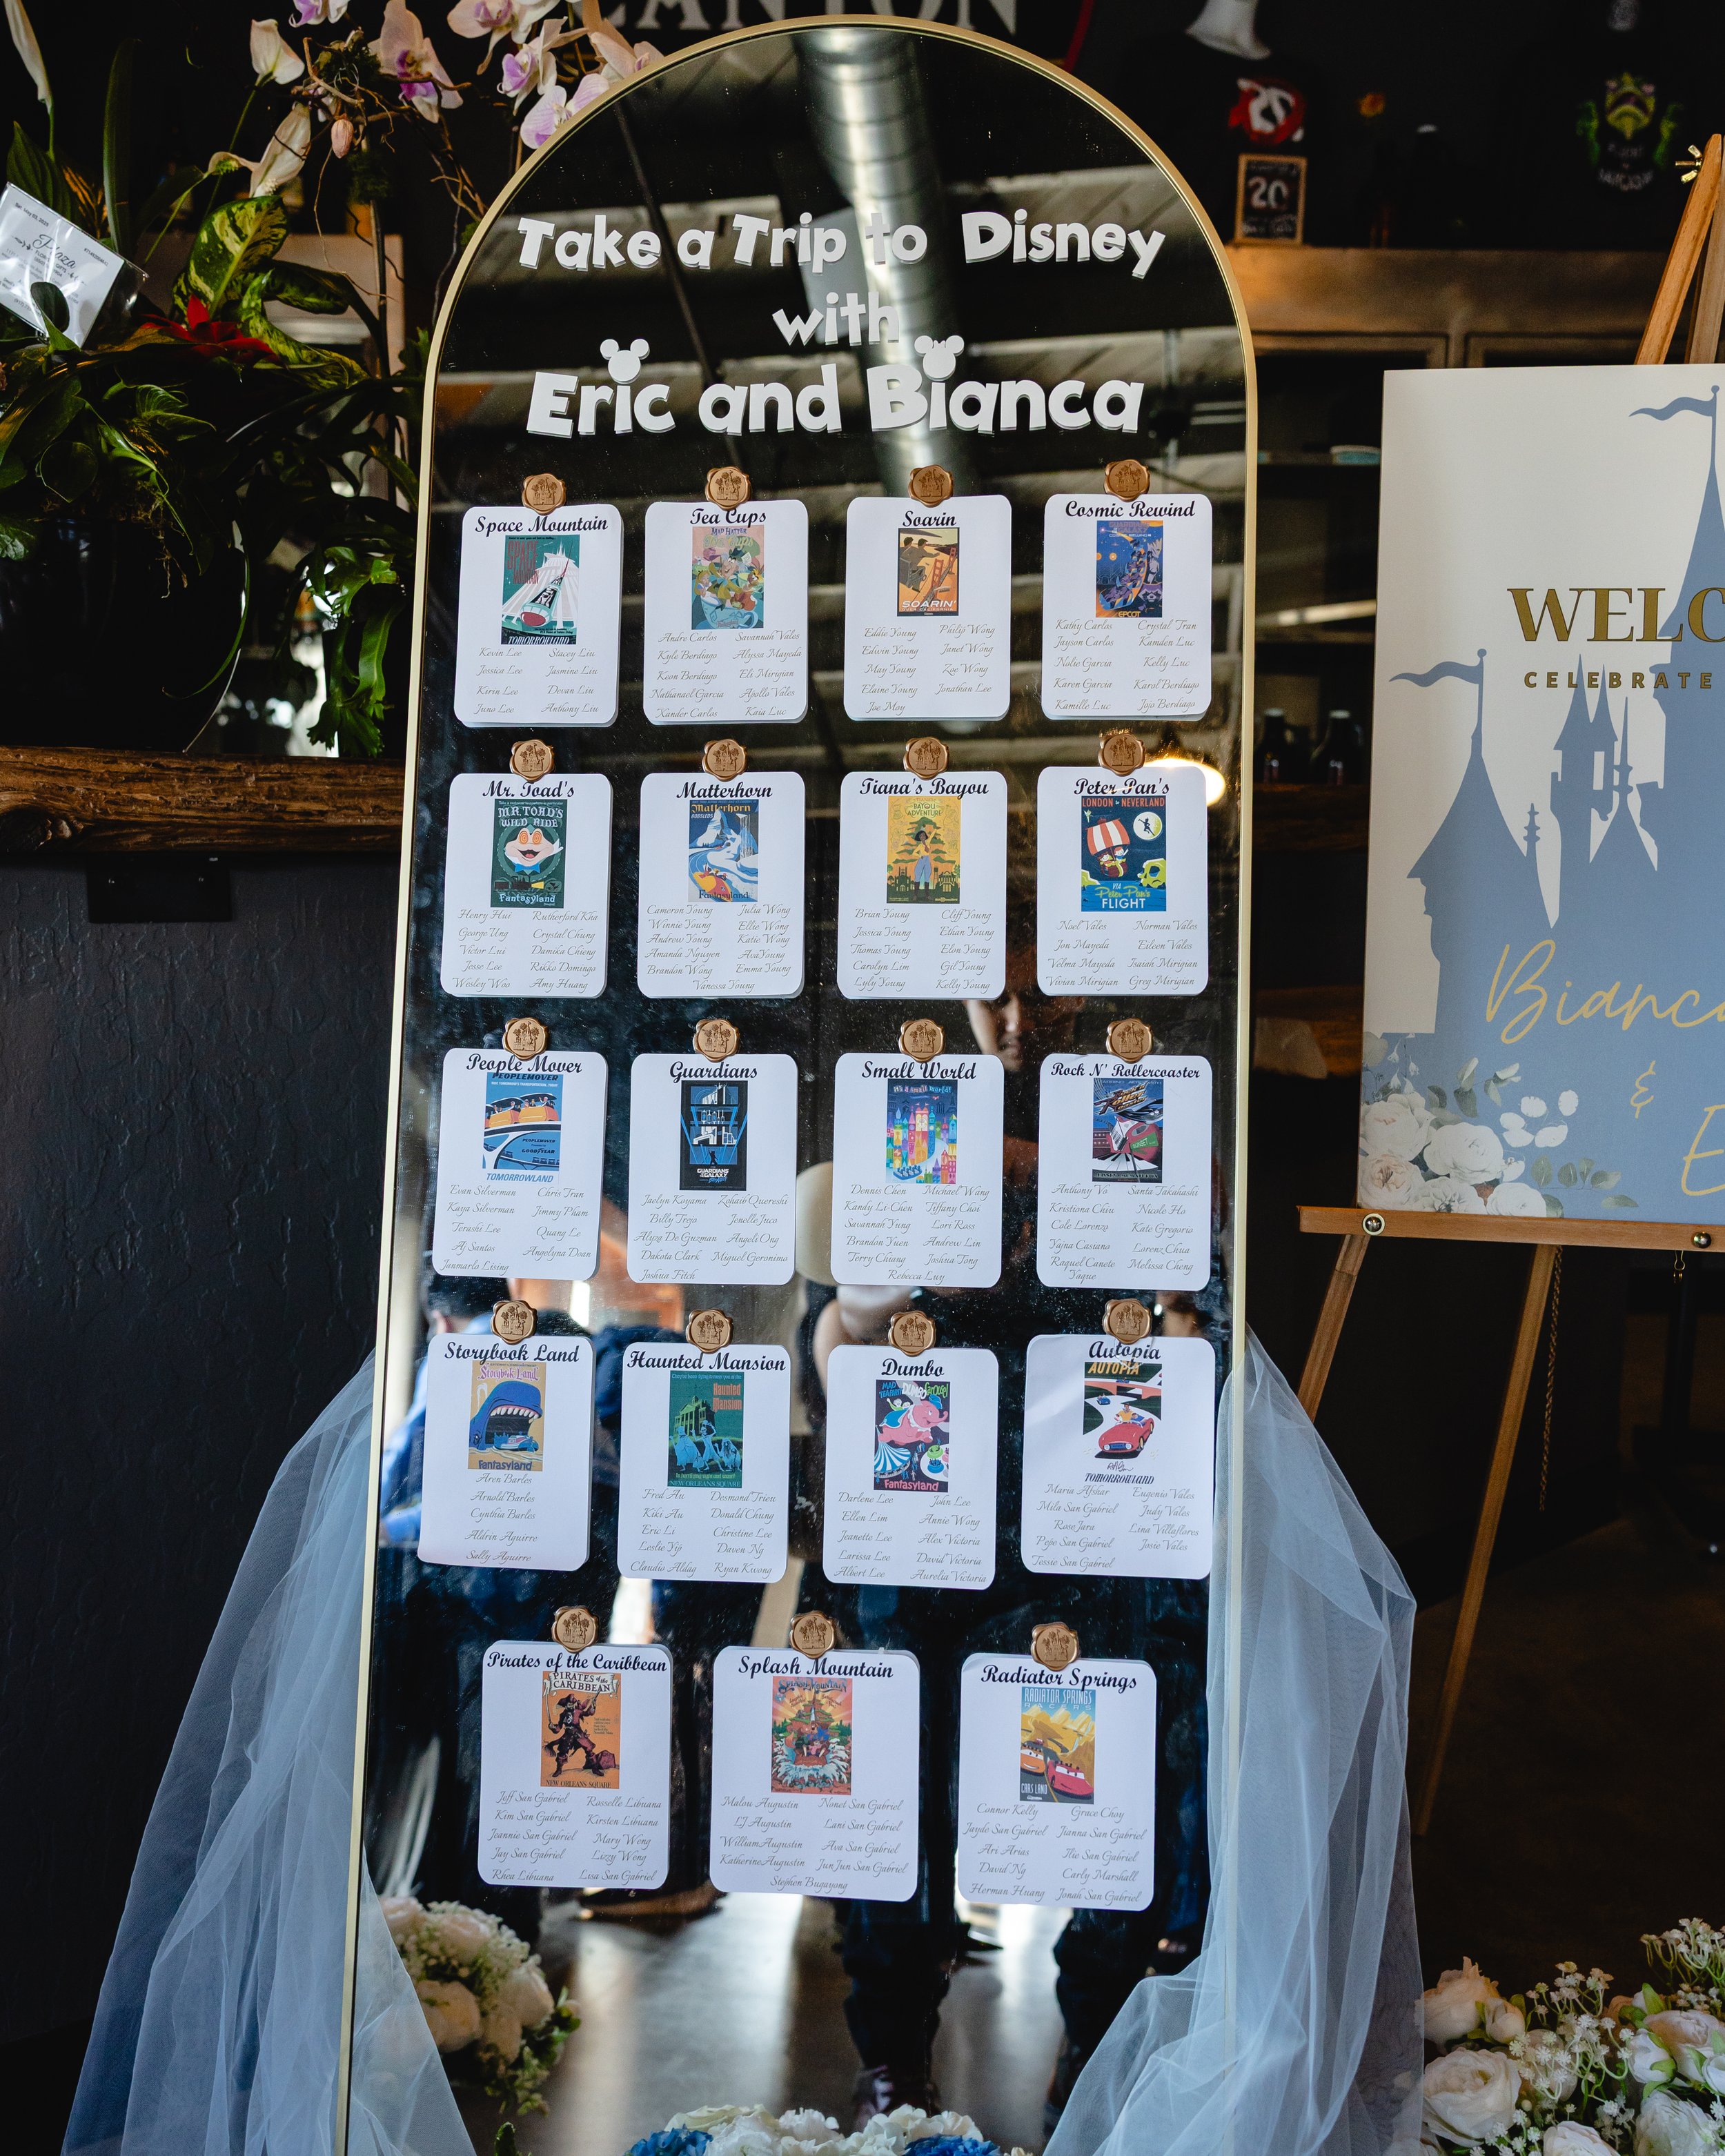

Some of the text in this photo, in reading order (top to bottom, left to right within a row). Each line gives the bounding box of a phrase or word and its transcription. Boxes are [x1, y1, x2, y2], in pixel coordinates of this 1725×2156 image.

[23, 208, 32, 217] May
[39, 218, 49, 226] 2025
[518, 209, 1165, 279] Take a Trip to Disney
[32, 235, 76, 268] Paza
[773, 293, 899, 347] with
[527, 338, 1144, 439] Eric and Bianca
[1065, 500, 1195, 517] Cosmic Rewind
[690, 508, 766, 528] Tea Cups
[903, 511, 956, 527] Soarin
[475, 515, 608, 537] Space Mountain
[507, 541, 538, 570] SPACE
[507, 636, 570, 644] TOMORROWLAND
[658, 633, 717, 642] Andre Carlos
[865, 627, 917, 641] Eddie Young
[478, 648, 522, 657] Kevin Lee
[1143, 657, 1190, 671] Kelly Luc
[1524, 671, 1712, 689] CELEBRATE
[482, 780, 575, 798] Mr. Toad's
[676, 782, 773, 798] Matterhorn
[860, 778, 989, 800] Tiana's Bayou
[1074, 778, 1170, 794] Peter Pan's
[691, 804, 751, 813] Matterhorn
[1082, 798, 1113, 807] LONDON
[1121, 798, 1165, 807] NEVERLAND
[498, 807, 564, 818] MR. TOAD'S
[501, 819, 558, 827] WILD RIDE
[499, 893, 555, 904] Fantasyland
[699, 889, 749, 899] Fantasyland
[1095, 886, 1150, 898] Peter Pan's
[1102, 898, 1145, 909] FLIGHT
[856, 908, 910, 922] Brian Young
[460, 945, 506, 955] Victor Lui
[1138, 940, 1192, 950] Eileen Vales
[693, 980, 755, 994] Vanessa Young
[1486, 939, 1725, 1044] Bianc
[466, 1054, 582, 1074] People Mover
[862, 1060, 976, 1080] Small World
[1051, 1062, 1200, 1078] Rock N' Rollercoaster
[492, 1073, 558, 1081] PEOPLEMOVER
[670, 1061, 758, 1083] Guardians
[1630, 1060, 1656, 1119] &
[1132, 1139, 1148, 1149] SUNSET
[486, 1173, 553, 1183] TOMORROWLAND
[450, 1185, 517, 1196] Evan Silverman
[1136, 1204, 1186, 1215] Nicole Ho
[931, 1219, 976, 1230] Lori Ross
[640, 1249, 700, 1260] Dakota Clark
[444, 1342, 580, 1365] Storybook Land
[1089, 1341, 1161, 1363] Autopia
[627, 1350, 786, 1371] Haunted Mansion
[882, 1358, 945, 1377] Dumbo
[477, 1364, 515, 1380] Storybook
[1087, 1362, 1139, 1374] AUTOPIA
[713, 1383, 740, 1396] Haunted
[902, 1383, 926, 1399] DUMBO
[925, 1382, 948, 1398] Carousel
[713, 1398, 742, 1411] Mansion
[478, 1460, 532, 1471] Fantasyland
[476, 1473, 532, 1484] Aren Barles
[884, 1479, 938, 1491] Fantasyland
[1085, 1472, 1154, 1484] TOMORROWLAND
[842, 1511, 888, 1522] Ellen Lim
[1138, 1505, 1190, 1520] Judy Vales
[642, 1524, 676, 1535] Eric Li
[487, 1652, 667, 1672] Pirates of the Caribbean
[738, 1656, 894, 1679] Splash Mountain
[553, 1672, 594, 1683] PIRATES
[981, 1664, 1137, 1694] Radiator Springs
[553, 1681, 611, 1692] CARIBBEAN
[778, 1679, 847, 1692] SPLASH MOUNTAIN
[1025, 1688, 1092, 1704] RADIATOR SPRINGS
[1024, 1703, 1092, 1711] RACERS
[1021, 1783, 1047, 1794] CARS LAND
[1071, 1806, 1125, 1823] Grace Choy
[749, 1817, 793, 1834] Augustin
[593, 1832, 652, 1851] Mary Weng
